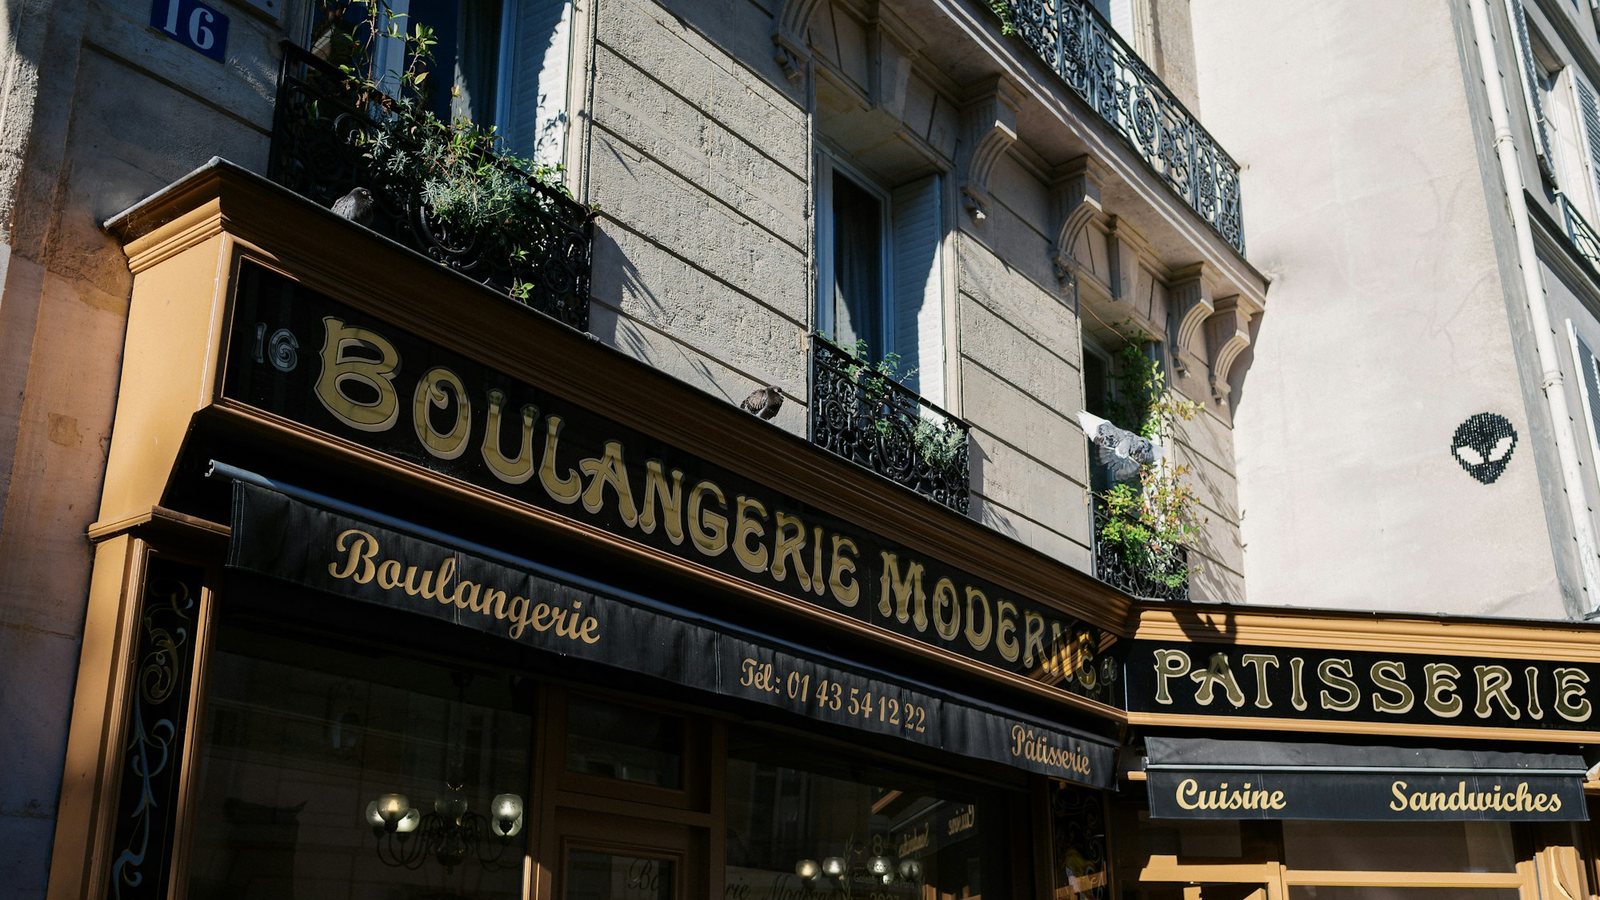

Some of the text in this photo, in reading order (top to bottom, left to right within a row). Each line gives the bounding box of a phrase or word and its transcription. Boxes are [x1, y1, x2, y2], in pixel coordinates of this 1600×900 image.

[163, 0, 215, 50] 16
[256, 315, 1097, 690] 16 BOULANGERIE MODERNE
[328, 529, 600, 644] Boulangerie
[740, 658, 926, 734] Tél: 01 43 54 12 22
[1152, 648, 1591, 723] PATISSERIE
[1011, 724, 1091, 776] Pâtisserie
[1176, 778, 1287, 811] Cuisine
[1389, 780, 1562, 813] Sandwiches
